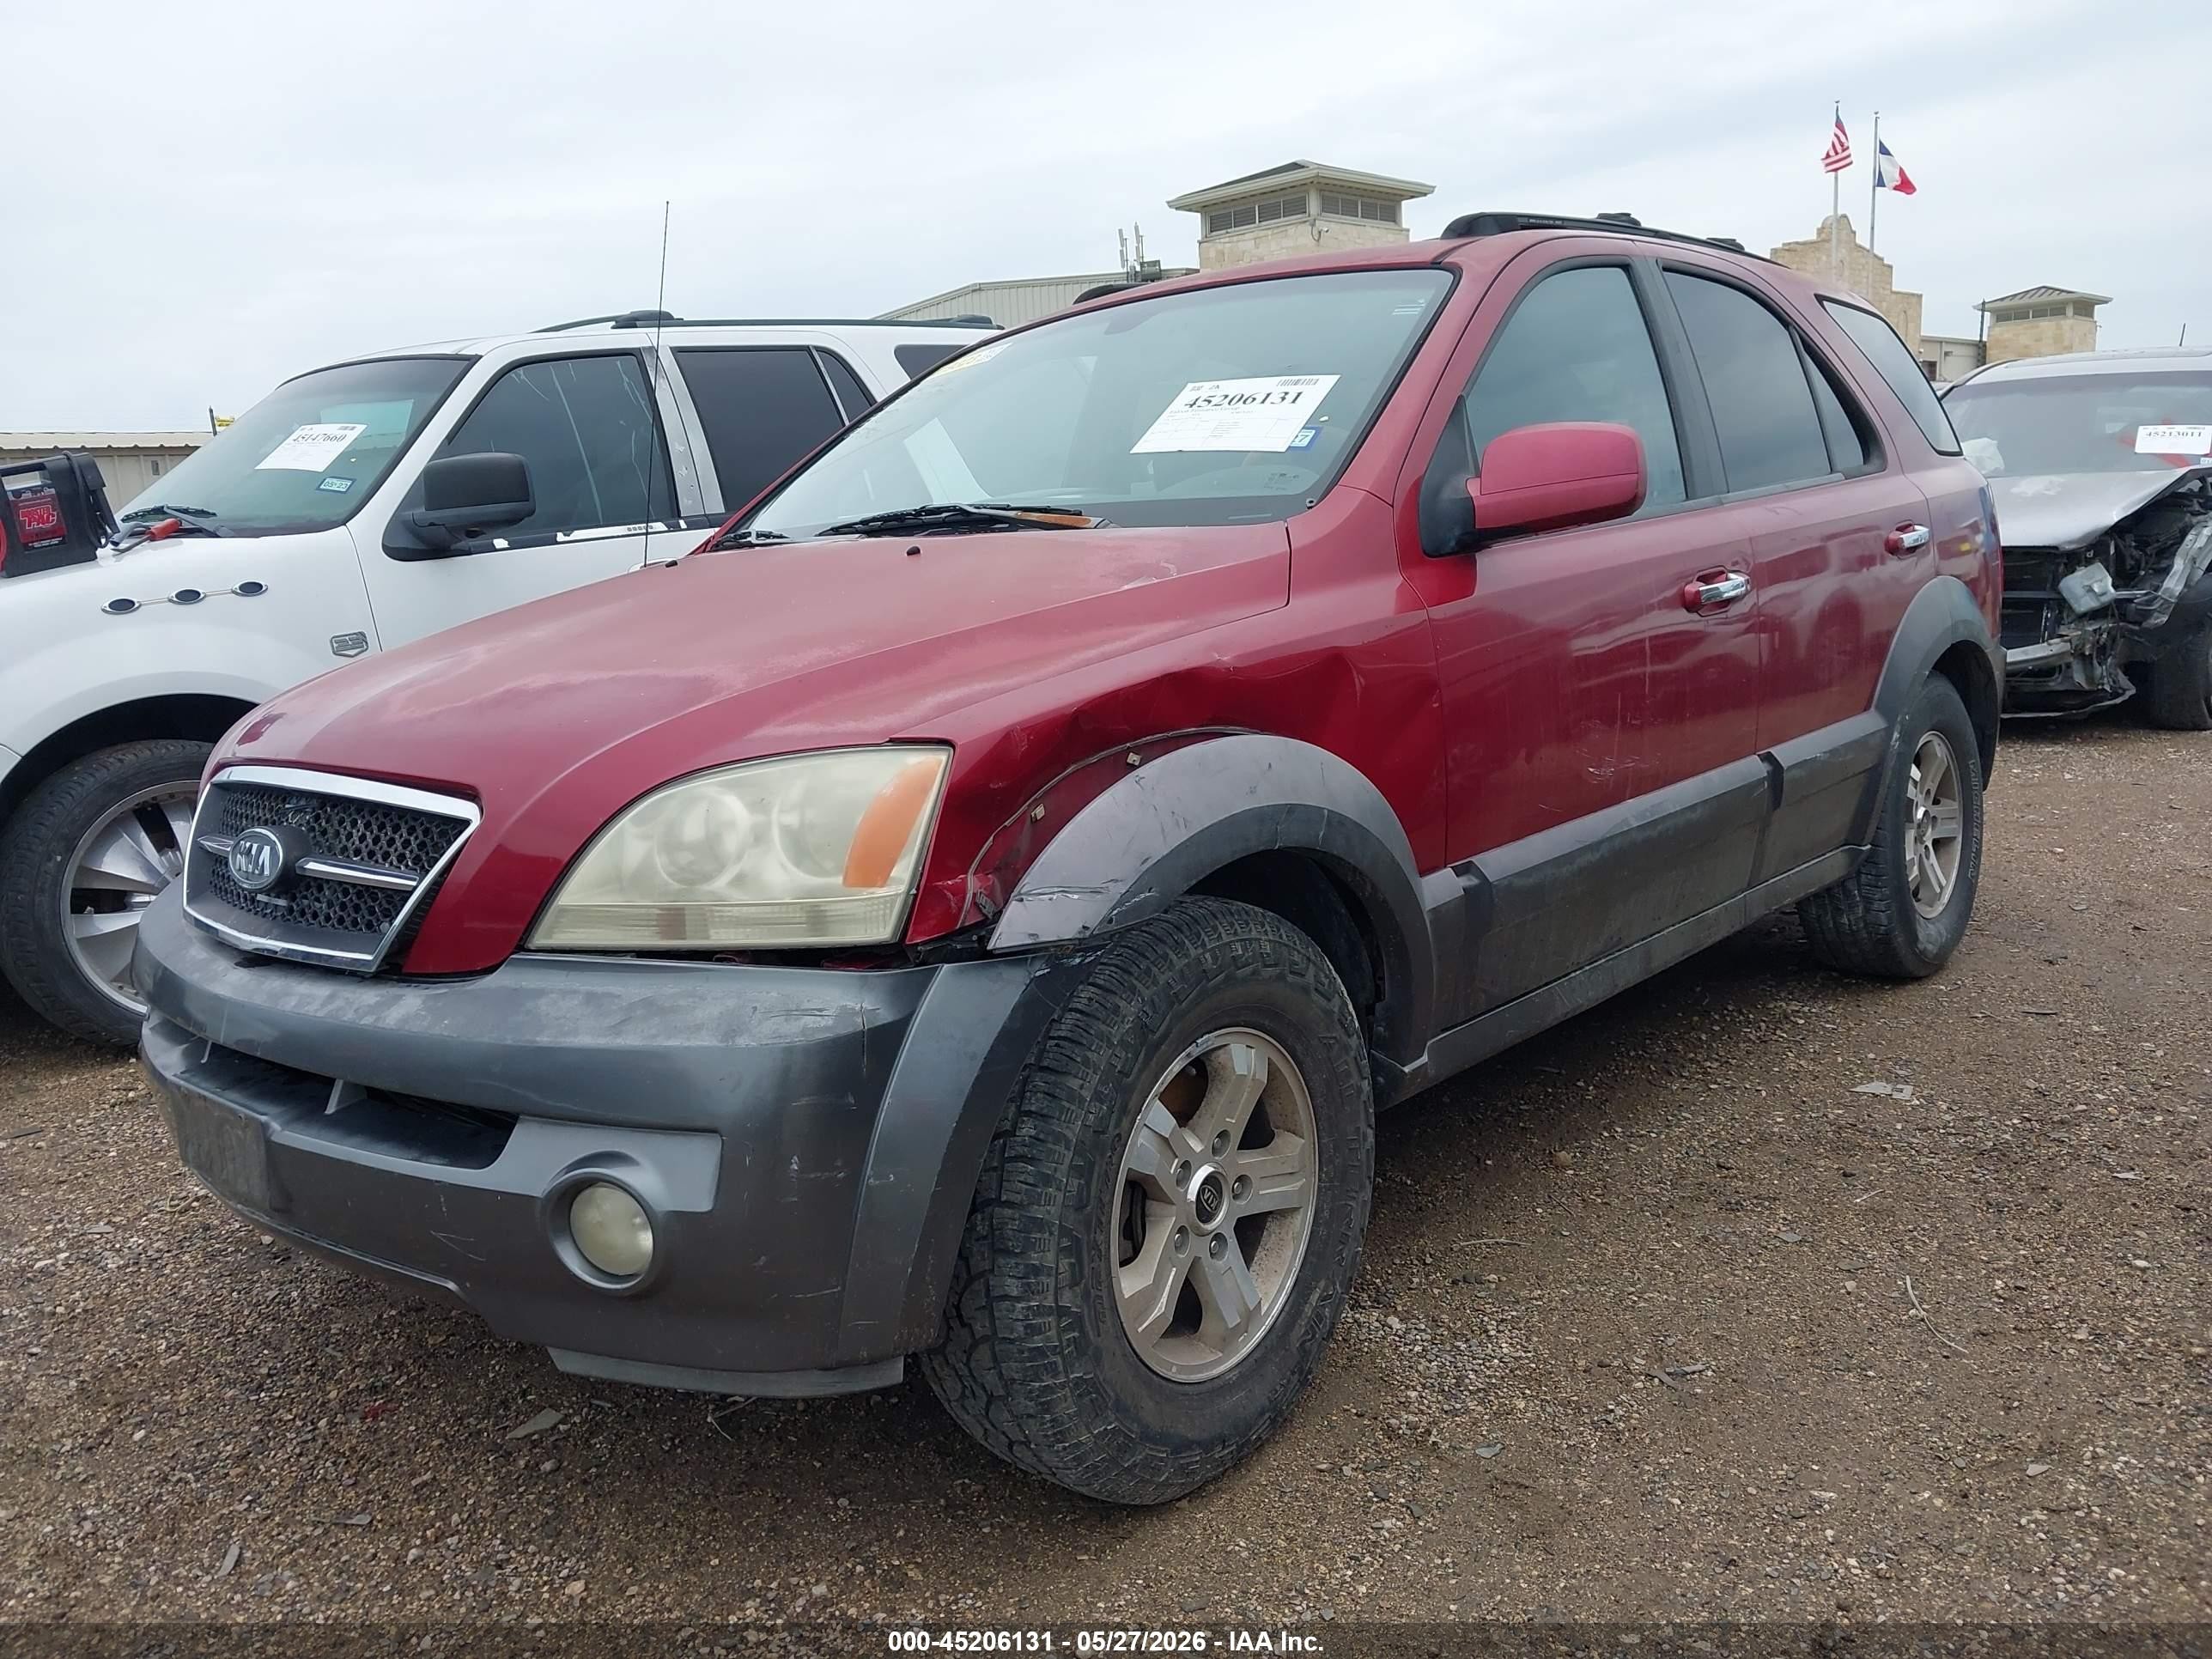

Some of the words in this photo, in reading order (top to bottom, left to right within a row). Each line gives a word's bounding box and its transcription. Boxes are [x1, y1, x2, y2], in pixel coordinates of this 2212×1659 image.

[1183, 391, 1304, 408] 45206131
[292, 433, 348, 443] 45147660
[235, 839, 271, 877] KIA
[1203, 1187, 1218, 1211] KIA
